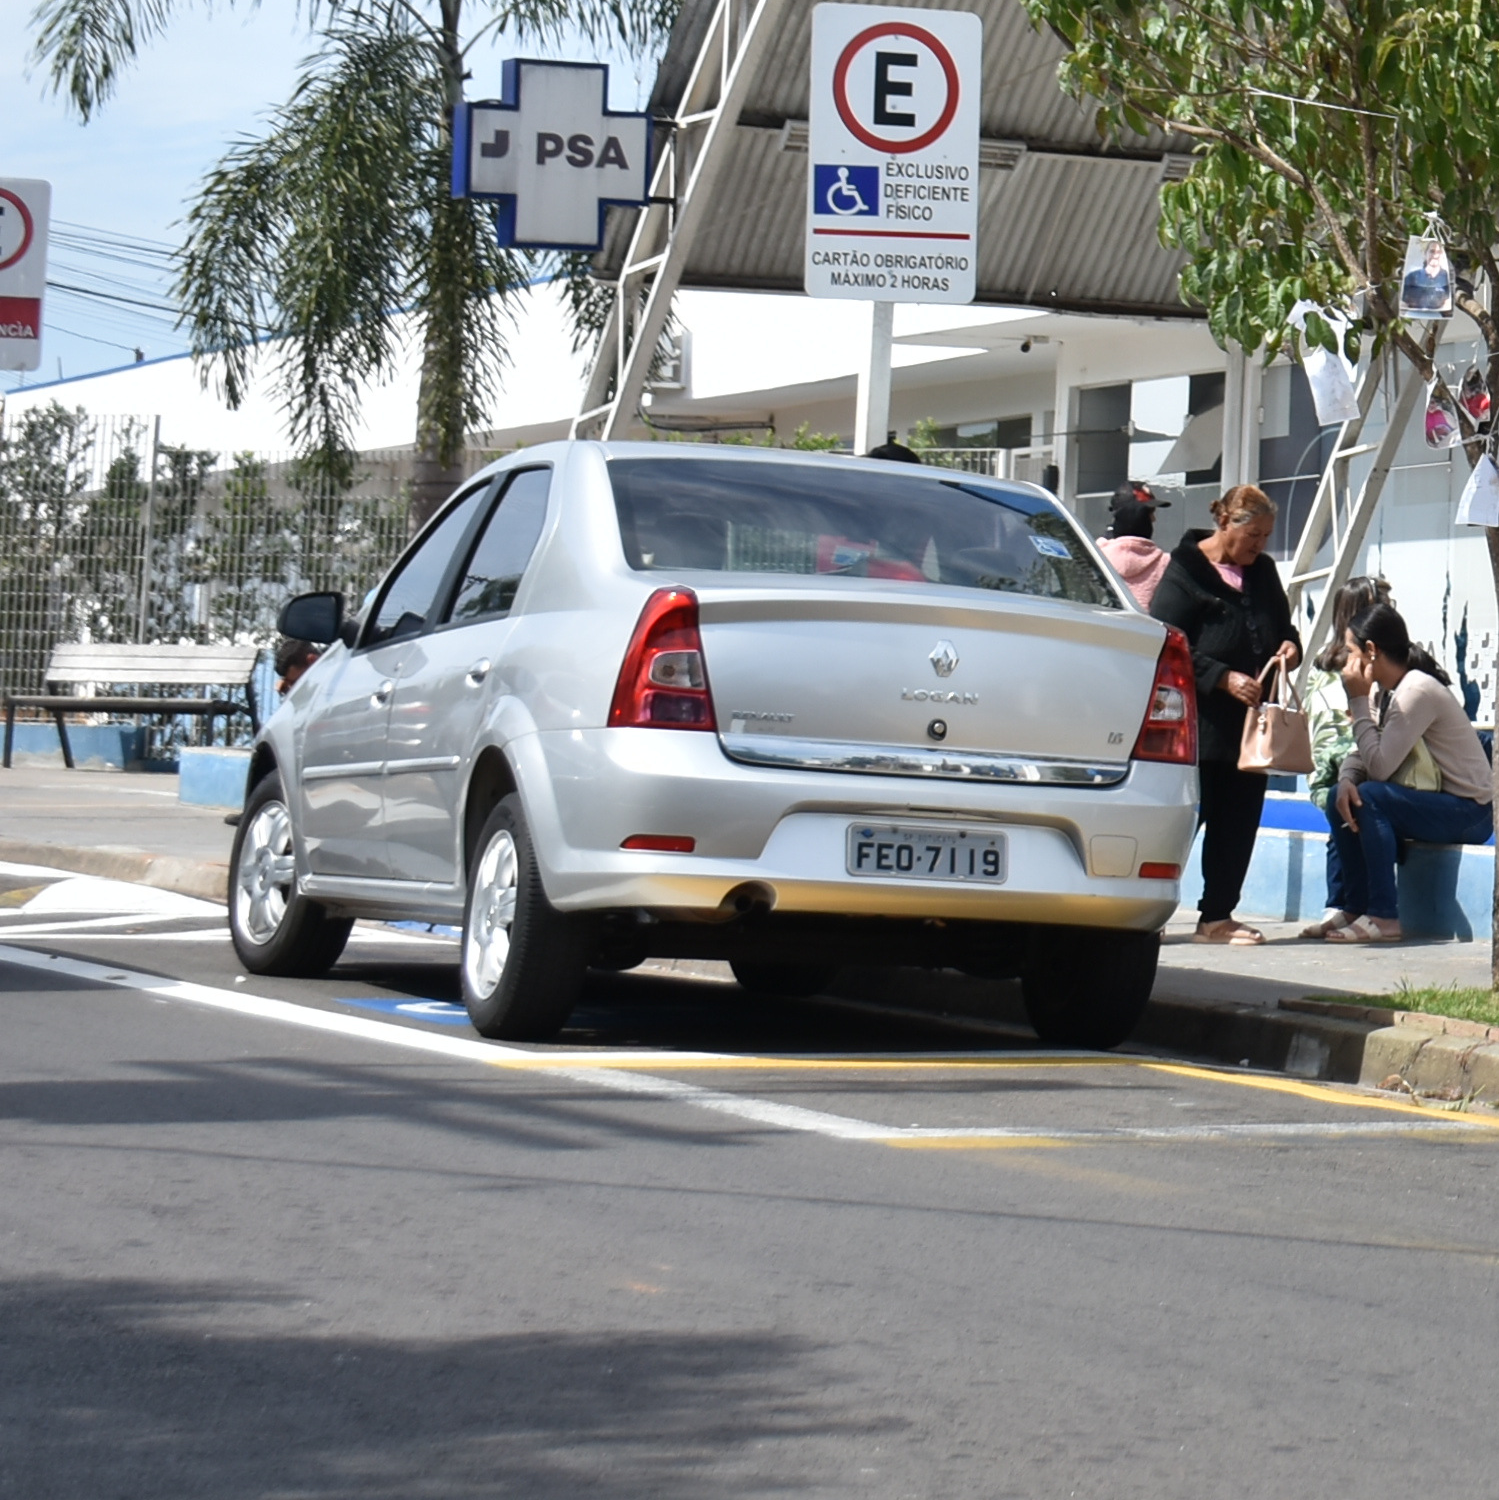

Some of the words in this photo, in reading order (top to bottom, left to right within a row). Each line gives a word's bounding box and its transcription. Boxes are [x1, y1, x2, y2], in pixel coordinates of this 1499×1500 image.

[872, 51, 918, 128] E
[536, 132, 629, 170] PSA
[885, 161, 970, 181] EXCLUSIVO
[883, 182, 970, 203] DEFICIENTE
[885, 200, 934, 222] FÍSICO
[811, 248, 871, 269] CARTÃO
[873, 249, 969, 272] OBRIGATÓRIO
[829, 269, 887, 290] MÁXIMO
[889, 275, 898, 289] 2
[900, 275, 950, 292] HORAS
[901, 687, 980, 706] LOGAN
